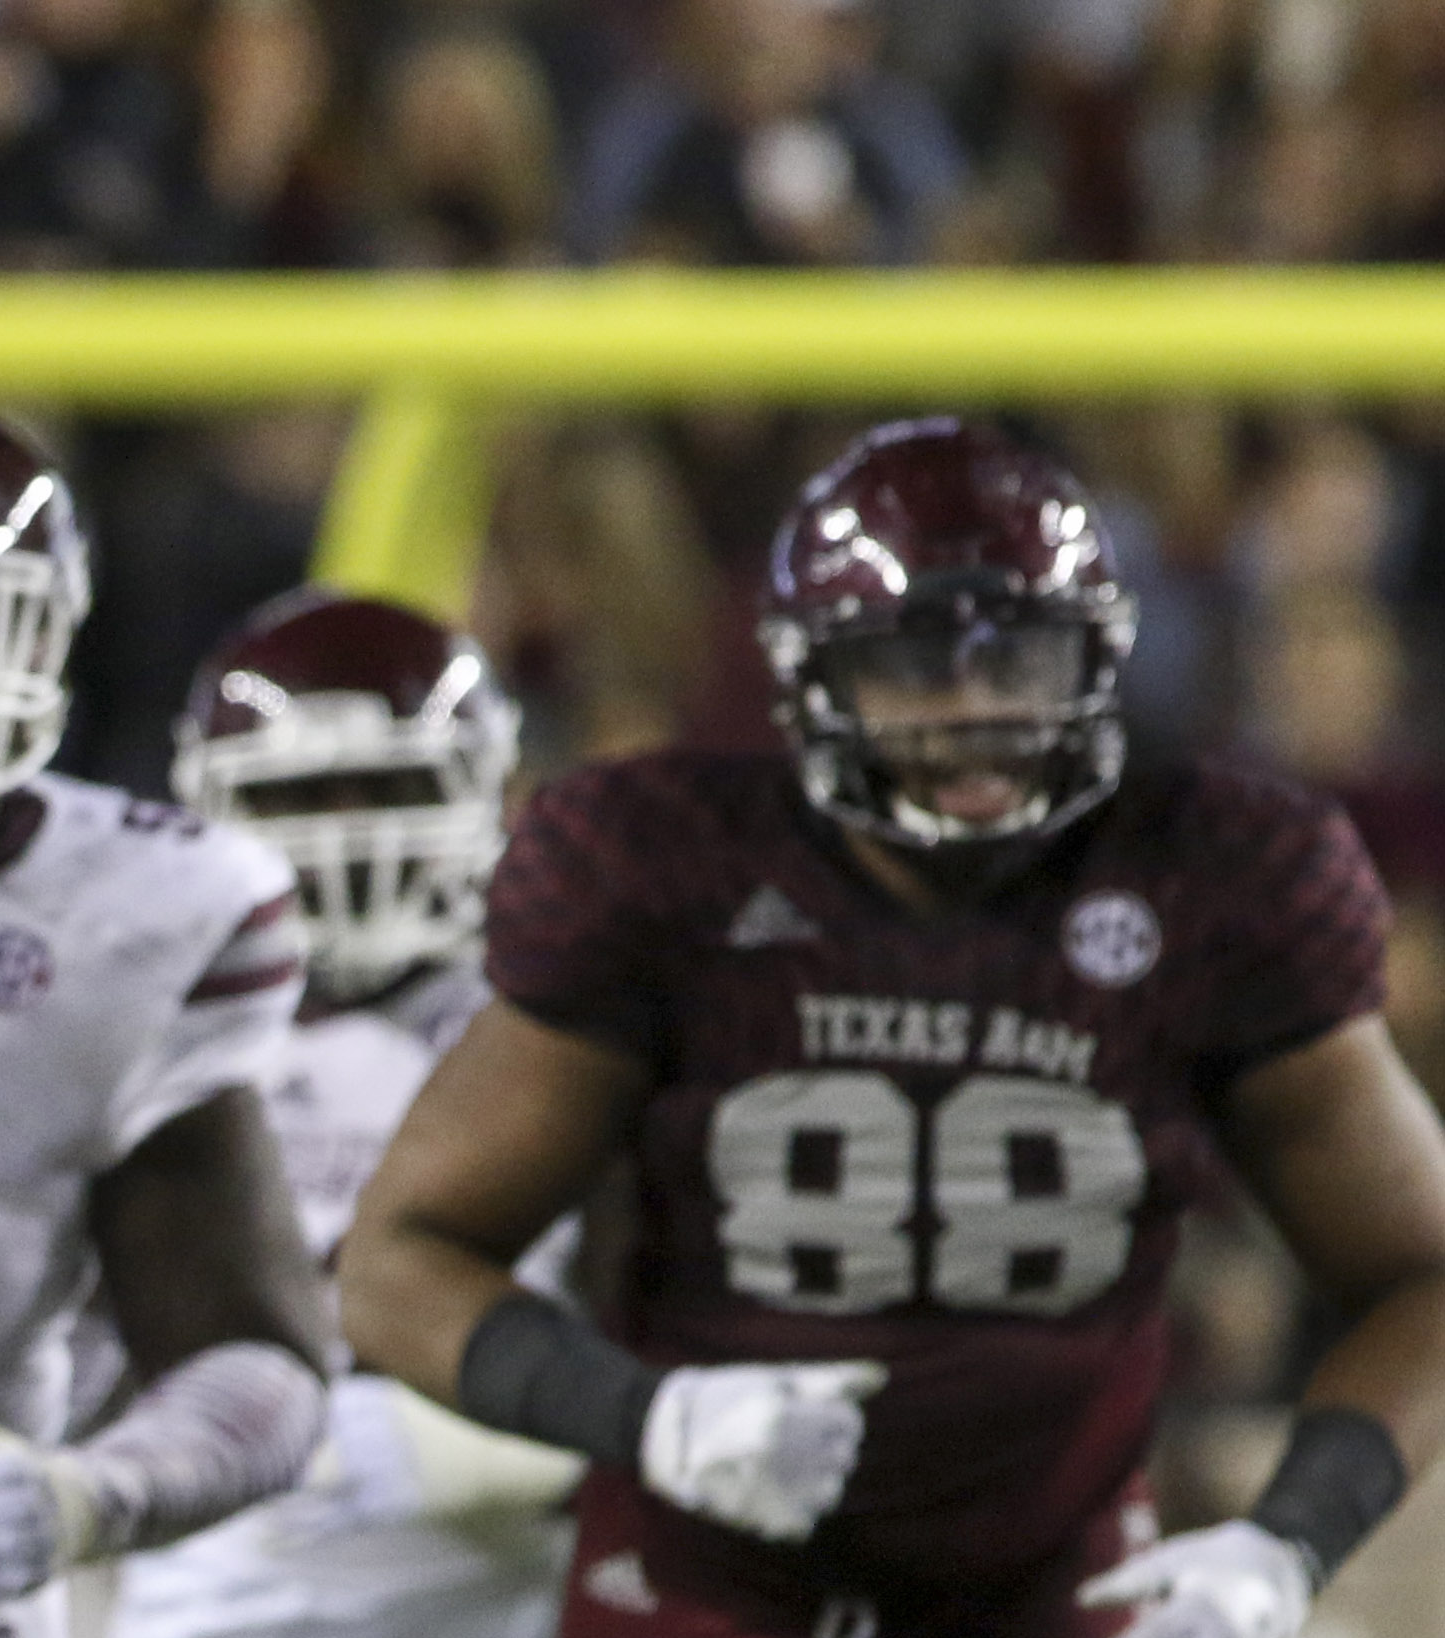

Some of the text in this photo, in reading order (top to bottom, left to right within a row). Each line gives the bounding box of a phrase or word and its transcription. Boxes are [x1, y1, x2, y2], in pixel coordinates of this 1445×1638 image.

[796, 992, 1098, 1085] TEXAS A&M
[708, 1068, 1147, 1318] 88
